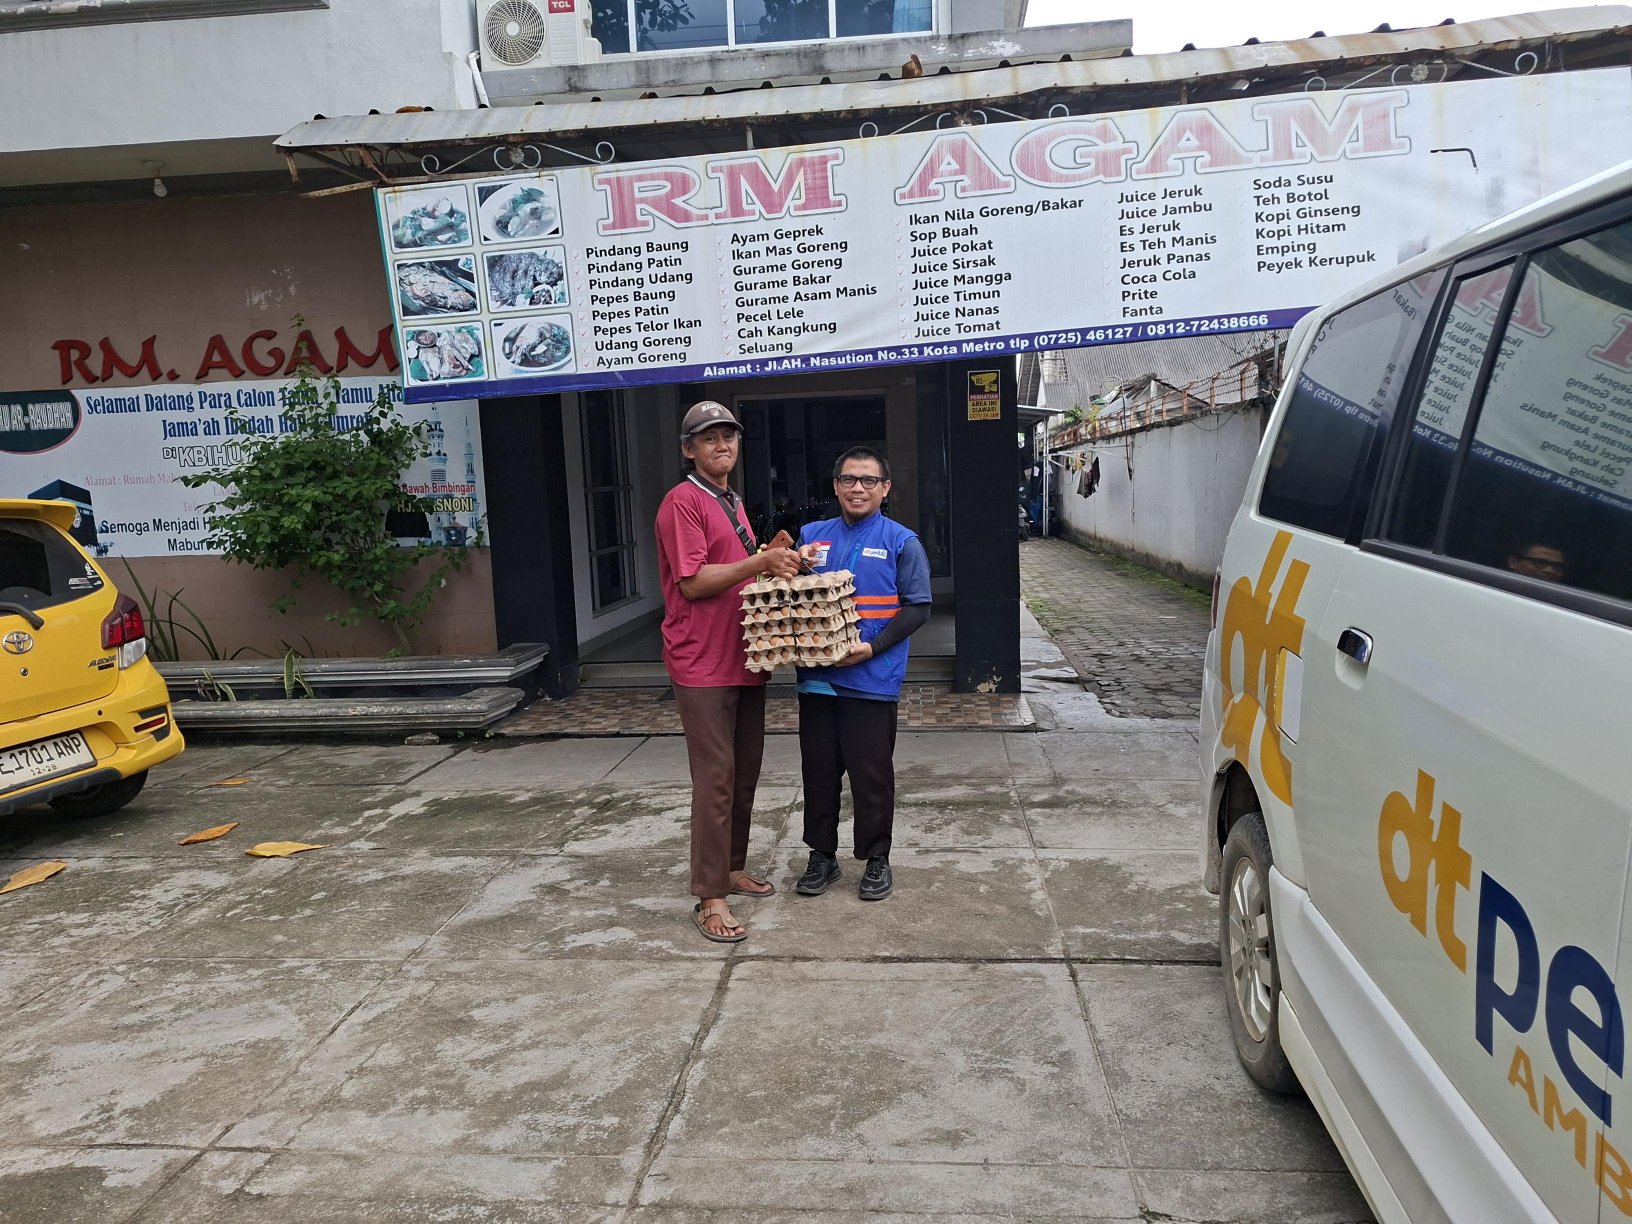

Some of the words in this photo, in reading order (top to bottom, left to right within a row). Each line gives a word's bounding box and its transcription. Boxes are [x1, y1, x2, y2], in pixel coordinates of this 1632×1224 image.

[594, 147, 848, 237] RM
[894, 89, 1411, 205] AGAM
[1253, 176, 1291, 190] Soda
[1297, 174, 1333, 186] Susu
[1118, 191, 1156, 204] Juice
[1162, 185, 1203, 199] Jeruk
[1254, 194, 1280, 206] Teh
[1287, 189, 1329, 203] Botol
[909, 214, 939, 226] Ikan
[945, 208, 974, 221] Nila
[979, 198, 1084, 218] Goreng/Bakar
[1118, 207, 1156, 220] Juice
[1162, 201, 1212, 216] Jambu
[1255, 209, 1291, 224] Kopi
[1296, 205, 1360, 218] Ginseng
[731, 233, 769, 246] Ayam
[774, 225, 824, 241] Geprek
[910, 231, 936, 243] Sop
[942, 224, 978, 238] Buah
[1120, 225, 1134, 236] Es
[1139, 220, 1181, 234] Jeruk
[1256, 225, 1292, 240] Kopi
[1298, 222, 1346, 235] Hitam
[586, 245, 641, 258] Pindang
[646, 241, 688, 252] Baung
[732, 249, 760, 260] Ikan
[766, 246, 792, 257] Mas
[797, 241, 848, 253] Goreng
[911, 246, 947, 258] Juice
[952, 239, 993, 254] Pokat
[1120, 242, 1135, 252] Es
[1140, 238, 1166, 250] Teh
[1172, 233, 1216, 247] Manis
[1257, 241, 1316, 256] Emping
[588, 261, 642, 274] Pindang
[648, 256, 682, 268] Patin
[733, 263, 786, 276] Gurame
[792, 258, 842, 270] Goreng
[912, 262, 948, 274] Juice
[953, 255, 996, 269] Sirsak
[1120, 255, 1162, 269] Jeruk
[1167, 252, 1210, 264] Panas
[1258, 257, 1303, 274] Peyek
[1309, 251, 1376, 267] Kerupuk
[590, 277, 644, 289] Pindang
[649, 272, 693, 284] Udang
[734, 280, 787, 291] Gurame
[793, 274, 831, 286] Bakar
[912, 279, 948, 290] Juice
[954, 271, 1011, 286] Mangga
[1121, 274, 1157, 285] Coca
[1163, 268, 1196, 281] Cola
[591, 294, 628, 306] Pepes
[633, 290, 675, 301] Baung
[736, 295, 789, 307] Gurame
[794, 290, 831, 302] Asam
[836, 284, 877, 298] Manis
[913, 294, 949, 306] Juice
[954, 288, 1000, 302] Timun
[1122, 289, 1158, 301] Prite
[592, 310, 630, 322] Pepes
[635, 305, 668, 317] Patin
[737, 310, 772, 323] Pecel
[777, 307, 804, 320] Lele
[914, 310, 950, 322] Juice
[955, 304, 999, 318] Nanas
[1123, 306, 1163, 318] Fanta
[594, 325, 631, 338] Pepes
[635, 321, 669, 333] Telor
[674, 318, 701, 329] Ikan
[738, 327, 763, 338] Cah
[768, 321, 836, 337] Kangkung
[915, 326, 951, 338] Juice
[955, 320, 1001, 334] Tomat
[595, 340, 638, 351] Udang
[643, 336, 691, 347] Goreng
[704, 363, 751, 377] Alamat
[810, 352, 873, 367] Nasution
[878, 347, 918, 360] No.33
[924, 344, 957, 356] Kota
[963, 340, 1004, 353] Metro
[1010, 337, 1029, 349] tlp
[1034, 332, 1081, 347] (0725)
[1086, 327, 1133, 341] 46127
[1148, 314, 1268, 336] 0812-72438666
[739, 342, 793, 354] Seluang
[51, 334, 180, 385] RM.
[195, 324, 400, 380] AGAM
[597, 356, 633, 369] Ayam
[638, 352, 686, 363] Goreng
[86, 394, 141, 415] Selamat
[144, 391, 194, 412] Datang
[198, 391, 231, 410] Para
[237, 389, 275, 408] Calon
[163, 447, 176, 459] Di
[84, 475, 116, 486] Alamat
[124, 474, 154, 485] Rumah
[432, 482, 475, 495] Bimbingan
[102, 520, 149, 535] Semoga
[153, 517, 199, 534] Menjadi
[9, 745, 54, 770] 1701
[53, 737, 81, 758] ANP
